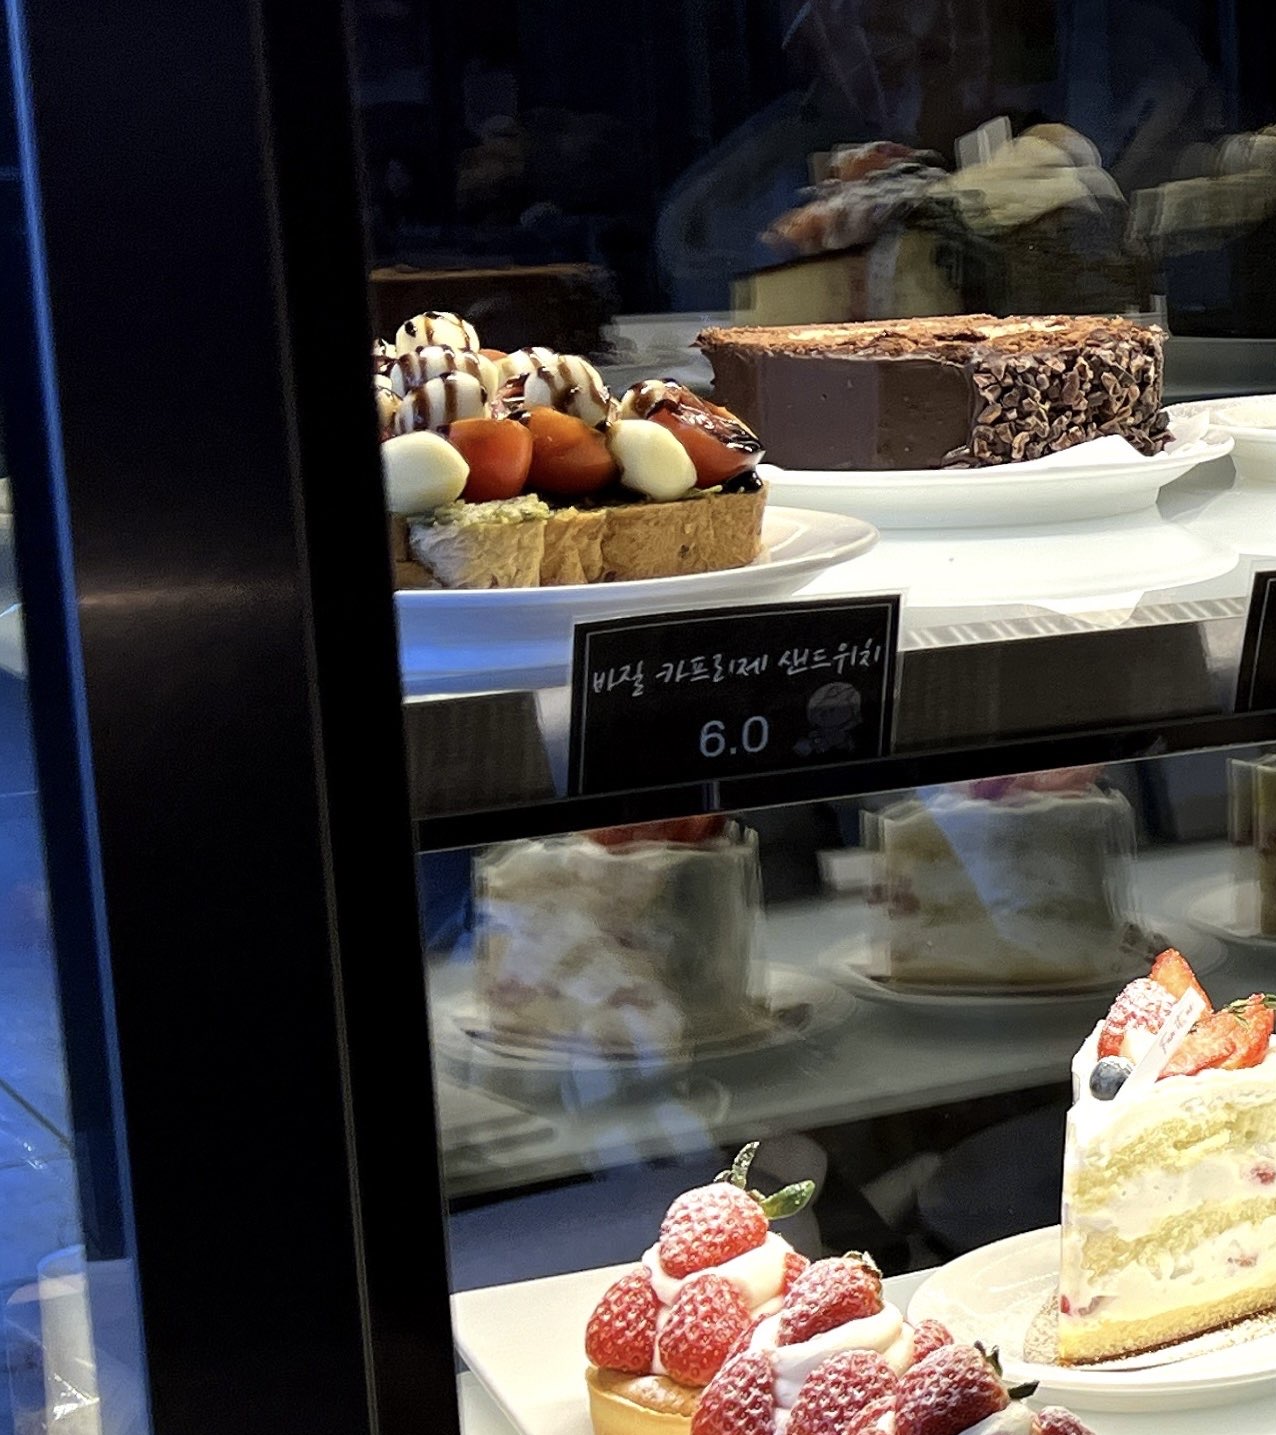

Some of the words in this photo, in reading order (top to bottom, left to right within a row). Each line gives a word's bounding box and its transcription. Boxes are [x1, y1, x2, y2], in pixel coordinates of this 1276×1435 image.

[592, 660, 644, 698] 바질
[655, 653, 768, 684] 카프리제
[778, 637, 881, 676] 샌드위치
[699, 715, 770, 758] 6.0
